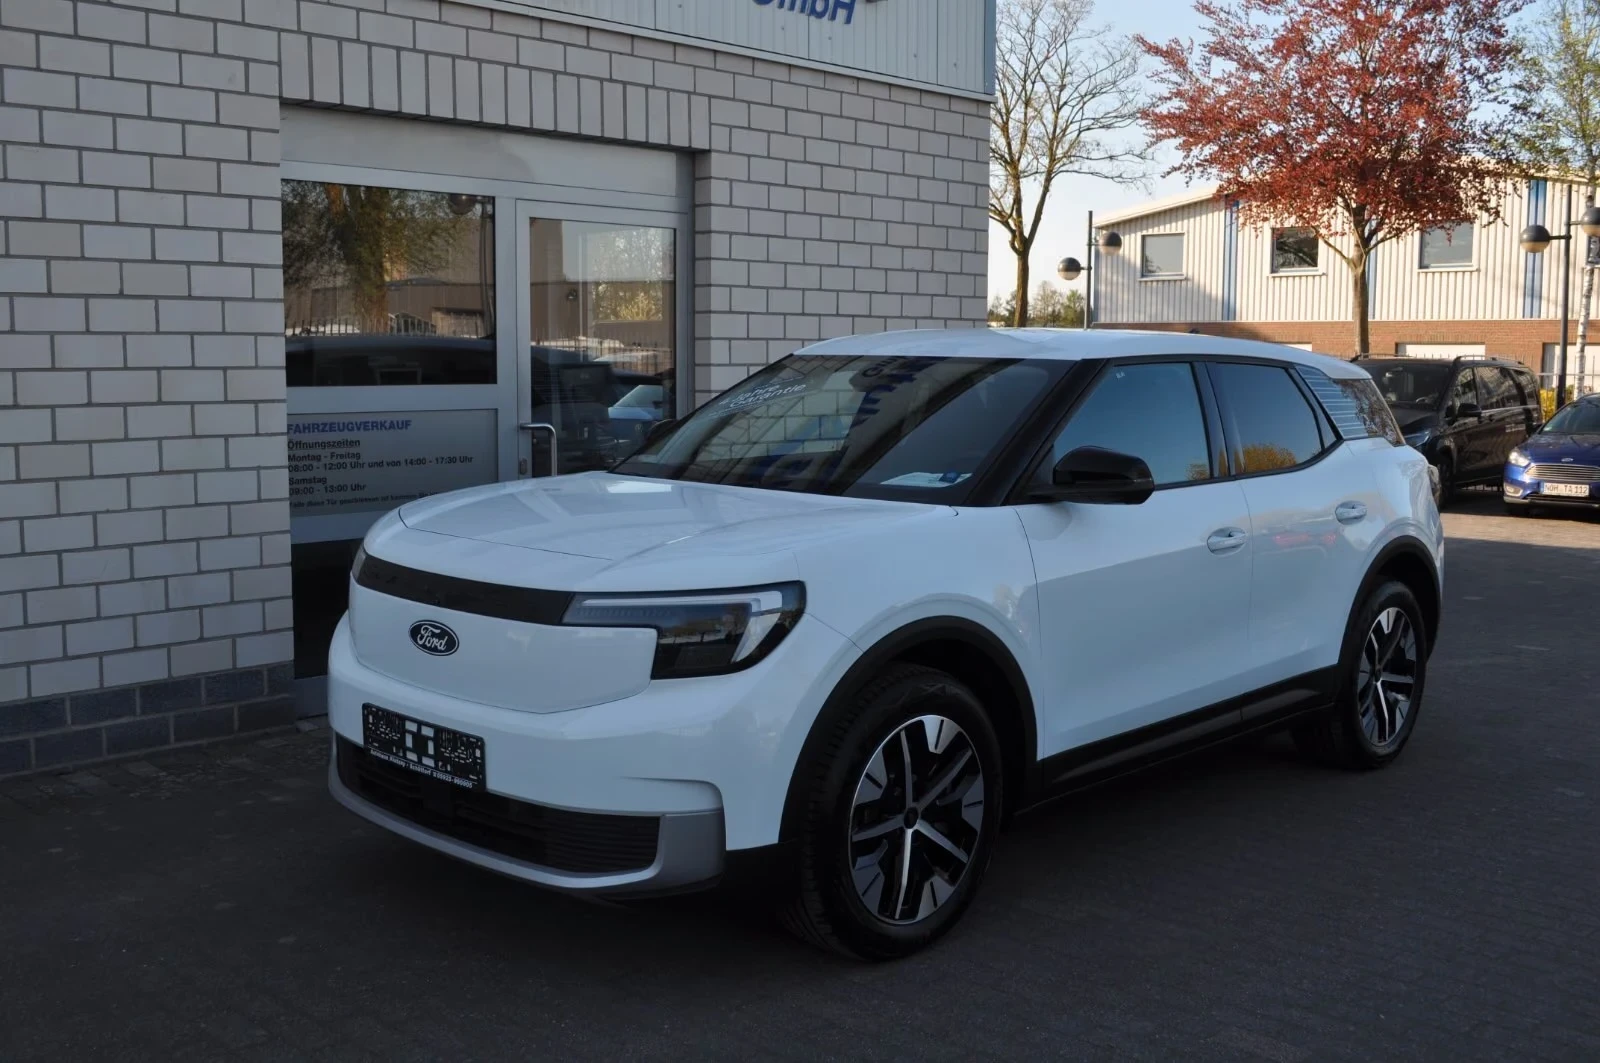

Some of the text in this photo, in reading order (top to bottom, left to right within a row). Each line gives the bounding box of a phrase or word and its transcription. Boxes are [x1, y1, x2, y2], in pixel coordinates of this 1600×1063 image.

[287, 420, 412, 434] FAHRZEUGVERKAUF
[288, 438, 361, 450] Öffnungszeiten
[288, 454, 321, 462] Montag
[330, 452, 361, 460] Freitag
[288, 464, 313, 472] 08:00
[324, 462, 347, 471] 12:00
[350, 461, 365, 469] Uhr
[368, 460, 384, 468] und
[404, 457, 427, 466] 14:00
[435, 456, 457, 464] 17:30
[289, 476, 327, 485] Samstag
[289, 486, 314, 495] 09:00
[324, 484, 348, 493] 13:00
[350, 483, 366, 491] Uhr
[417, 625, 449, 651] Ford
